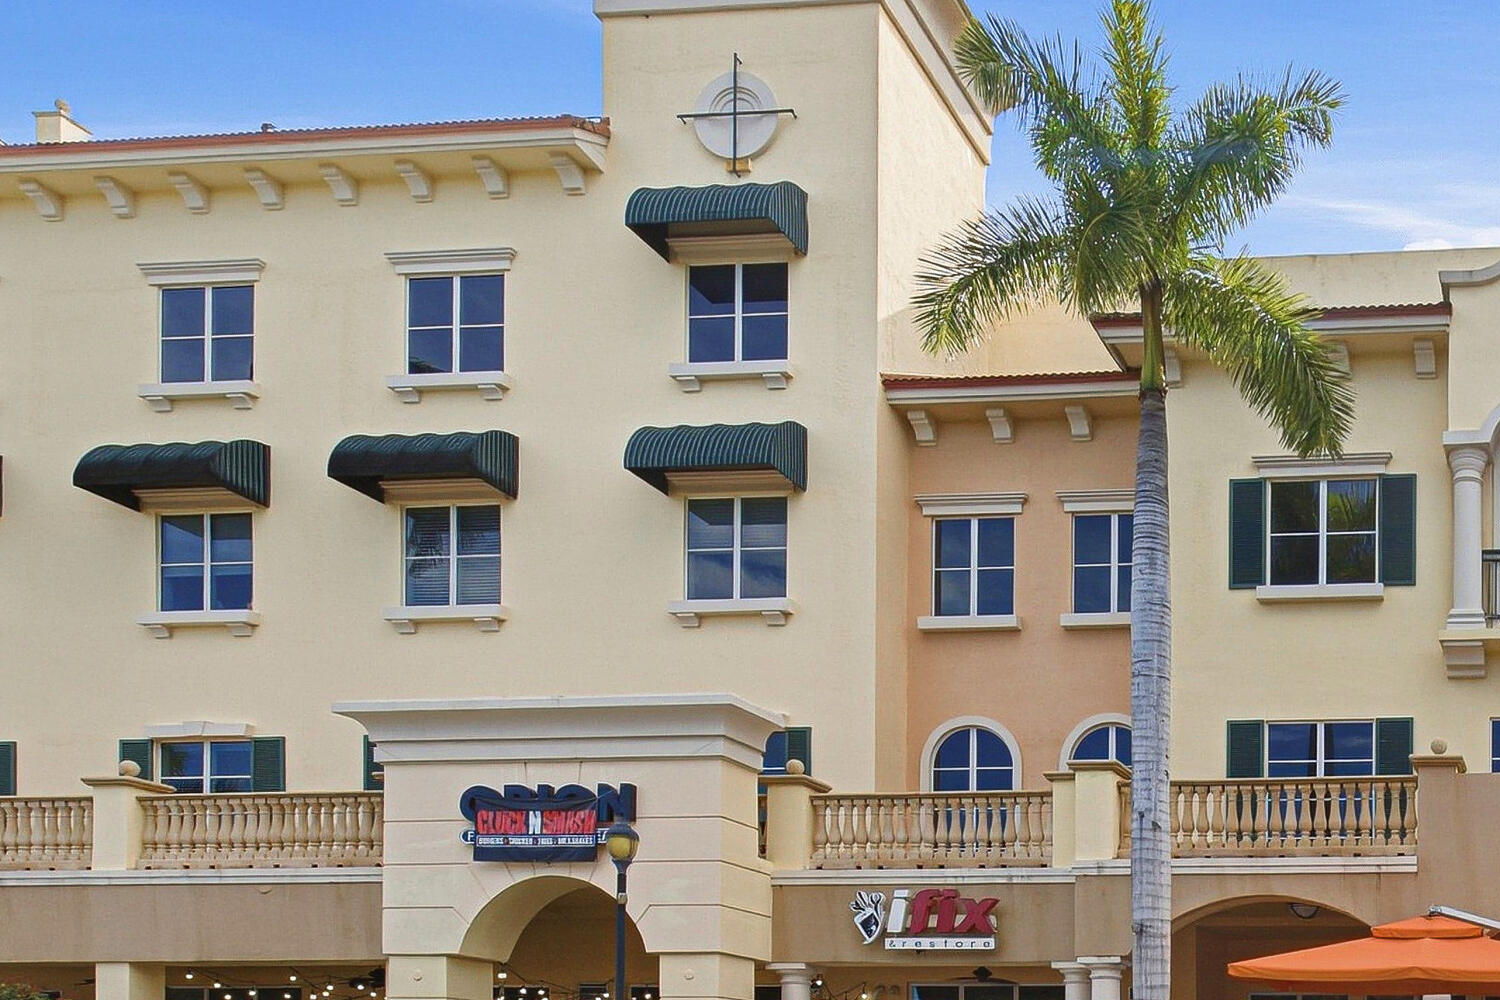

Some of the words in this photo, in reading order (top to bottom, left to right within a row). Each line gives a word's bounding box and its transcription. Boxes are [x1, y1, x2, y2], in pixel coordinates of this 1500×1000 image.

[476, 810, 527, 835] CLUCK
[528, 811, 542, 835] N
[542, 809, 597, 835] SMASH
